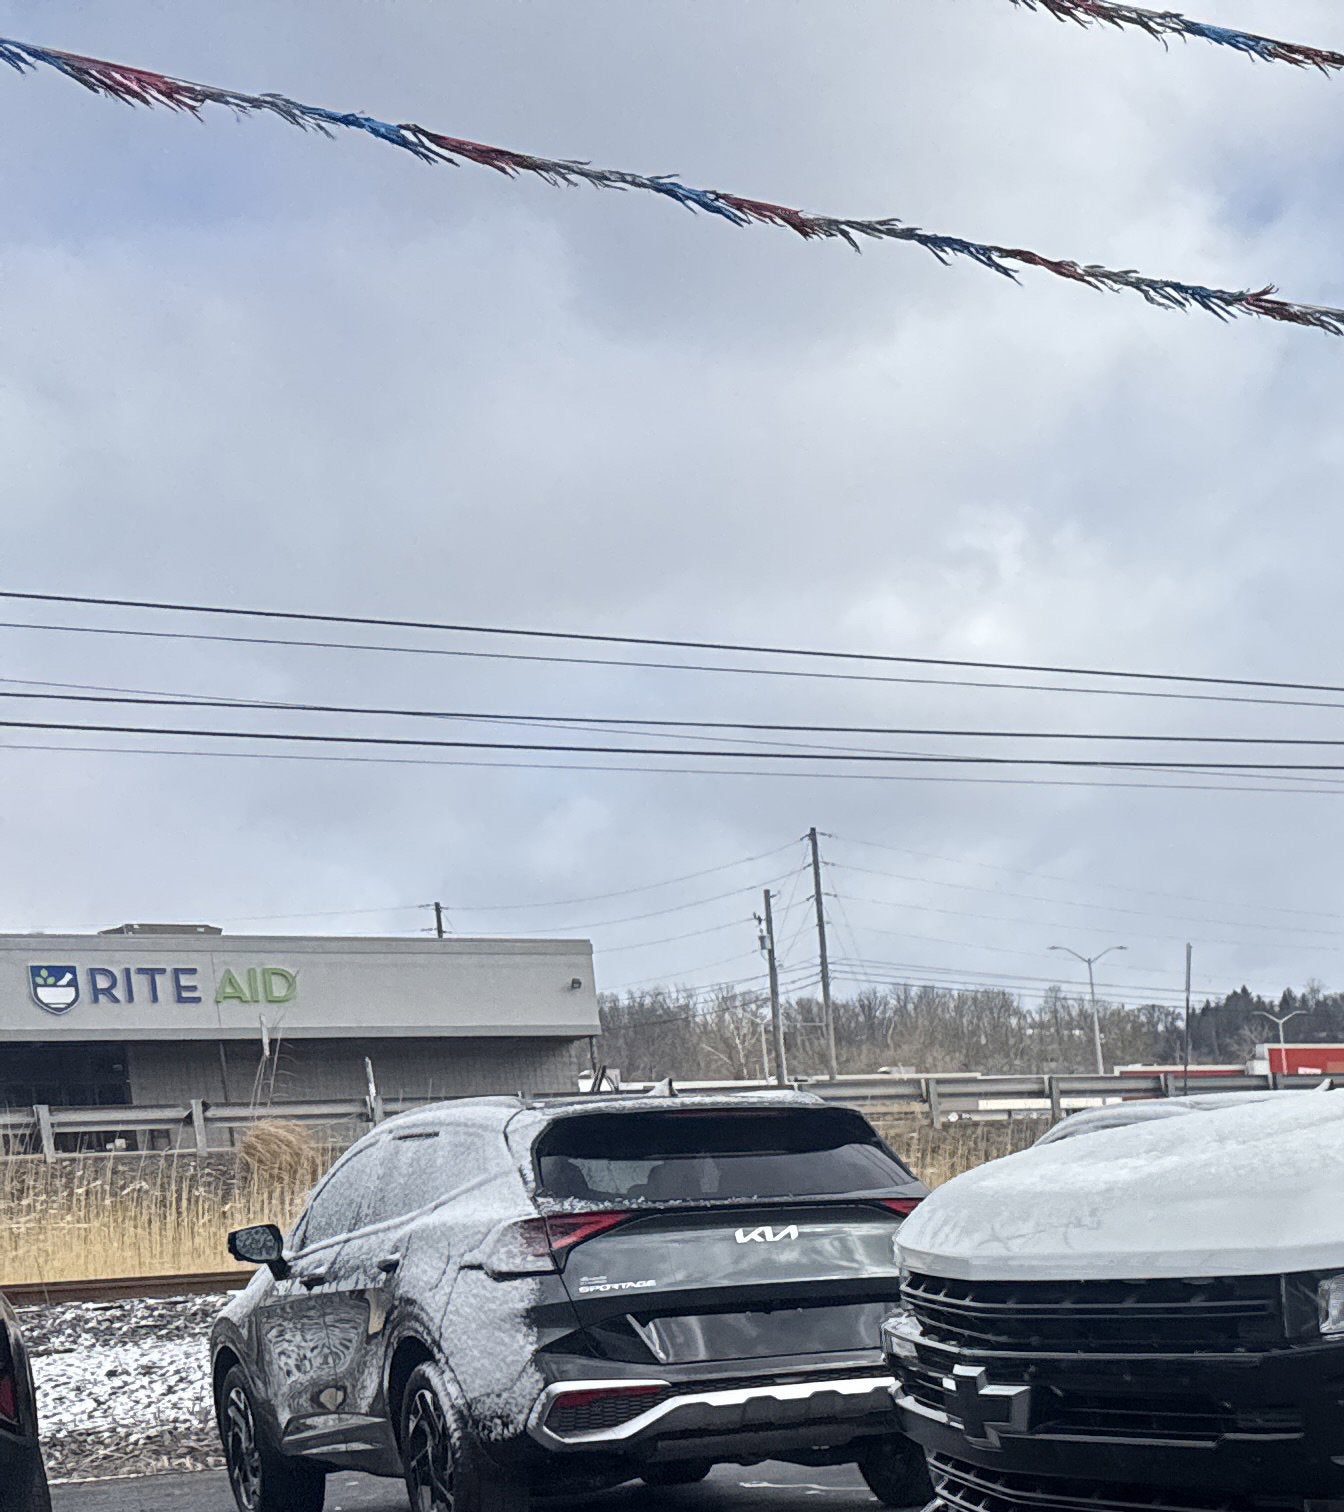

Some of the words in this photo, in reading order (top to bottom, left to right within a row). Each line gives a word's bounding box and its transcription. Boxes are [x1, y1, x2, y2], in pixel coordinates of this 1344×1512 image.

[88, 967, 202, 1004] RITE
[215, 967, 297, 1004] AID
[735, 1224, 799, 1243] KIA
